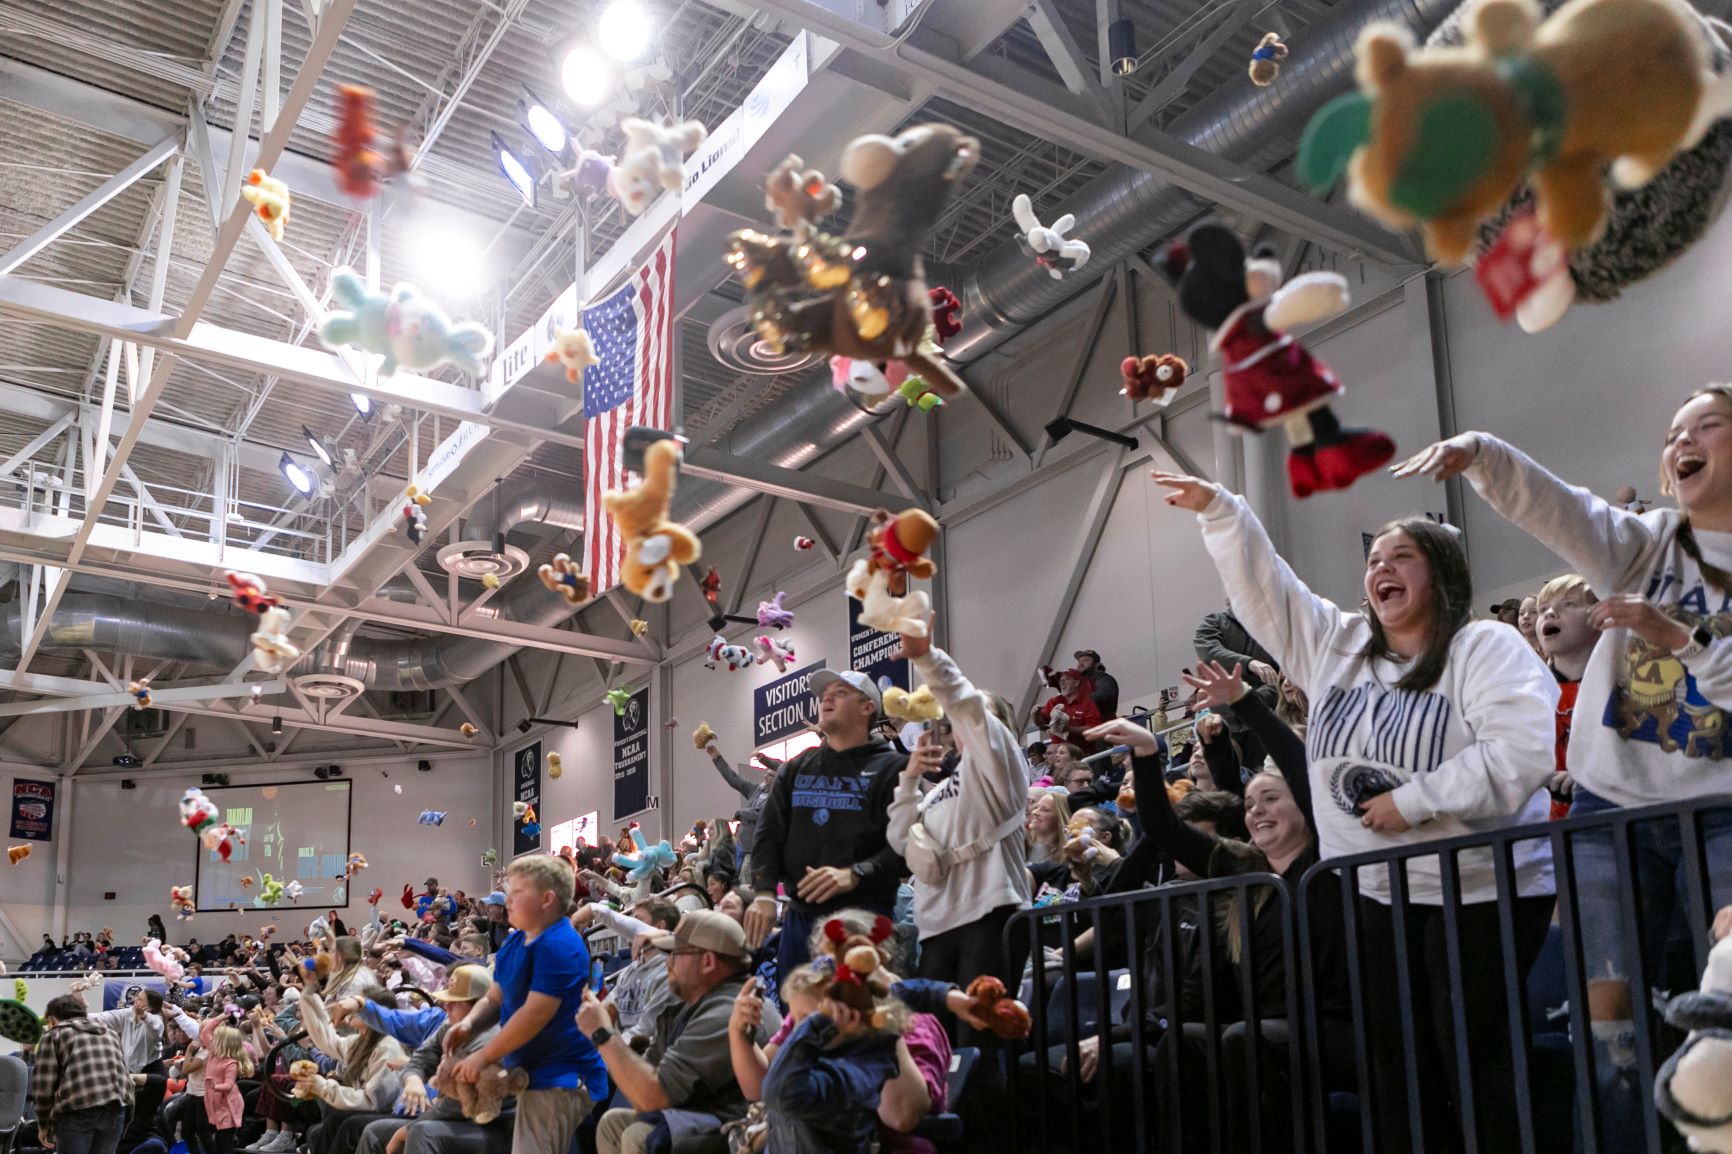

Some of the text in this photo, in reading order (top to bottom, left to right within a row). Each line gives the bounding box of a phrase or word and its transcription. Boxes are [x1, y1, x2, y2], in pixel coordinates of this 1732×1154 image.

[853, 632, 901, 658] CONFERENC
[759, 701, 804, 737] SECTION
[622, 741, 640, 759] NCAA
[615, 750, 647, 770] TOURNAMENT
[520, 787, 535, 801] NCAA
[647, 796, 659, 809] M
